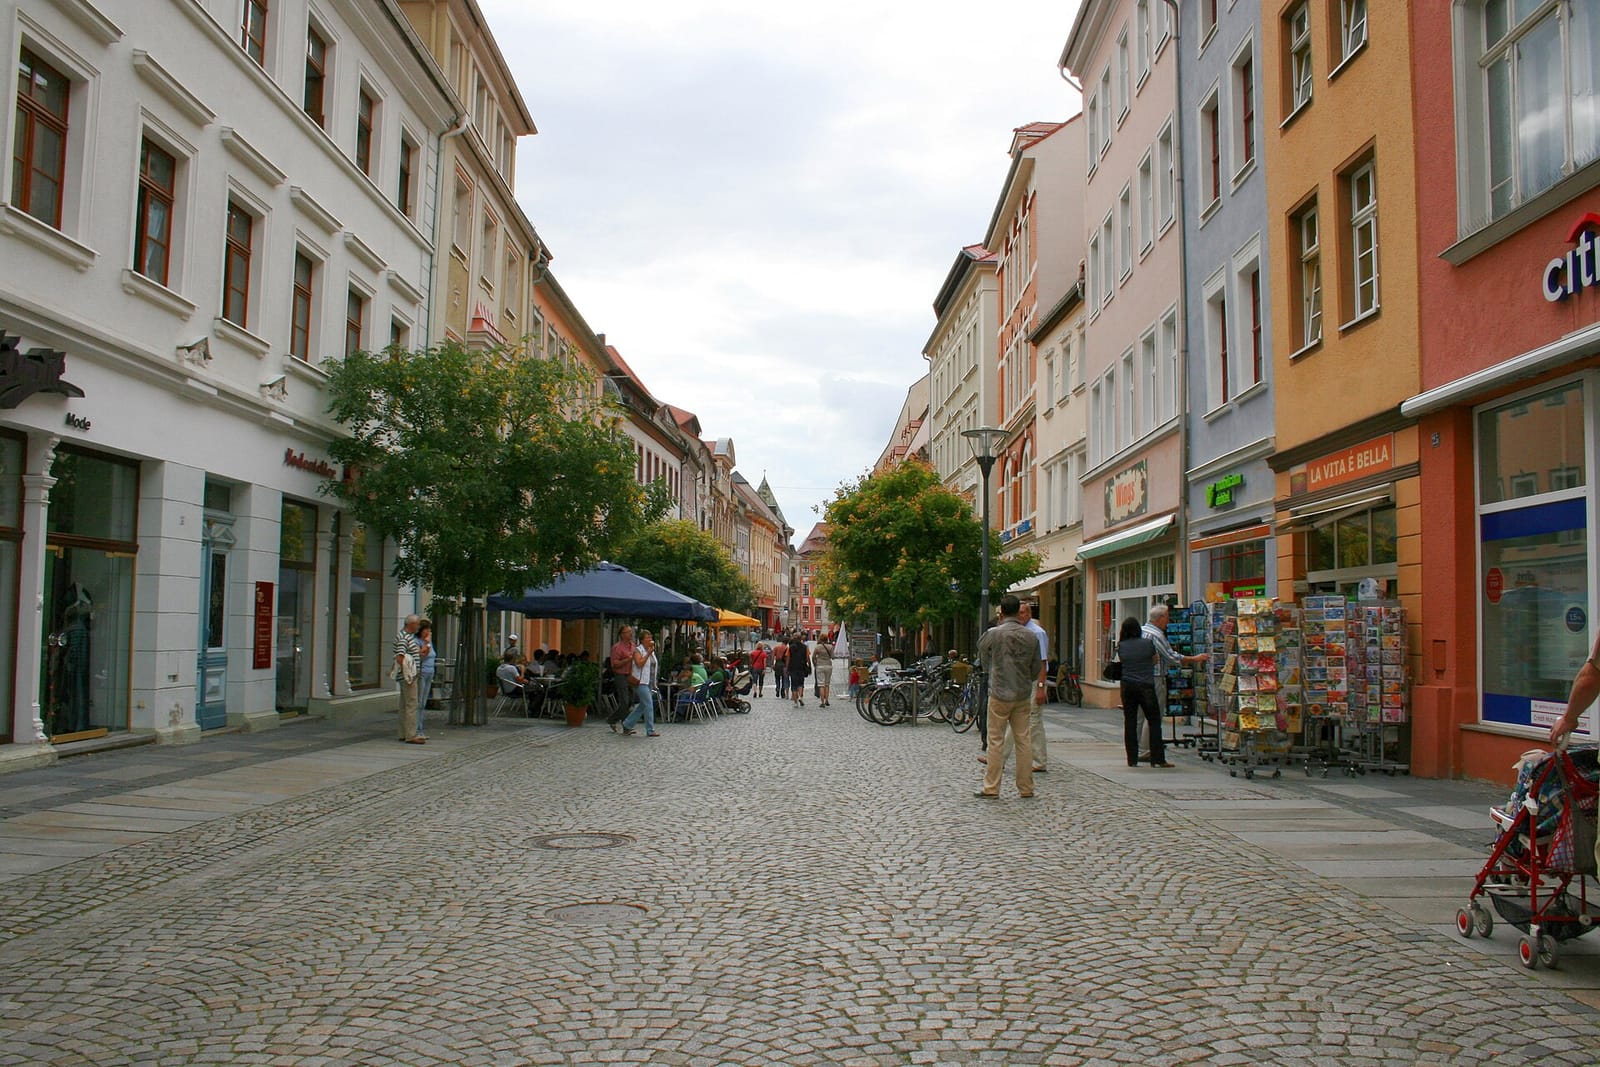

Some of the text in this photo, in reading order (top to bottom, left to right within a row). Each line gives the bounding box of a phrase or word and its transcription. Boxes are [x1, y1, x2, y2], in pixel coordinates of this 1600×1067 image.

[65, 411, 92, 431] Mode
[1310, 467, 1322, 484] LA
[1323, 458, 1346, 480] VITA
[1356, 444, 1389, 469] BELLA
